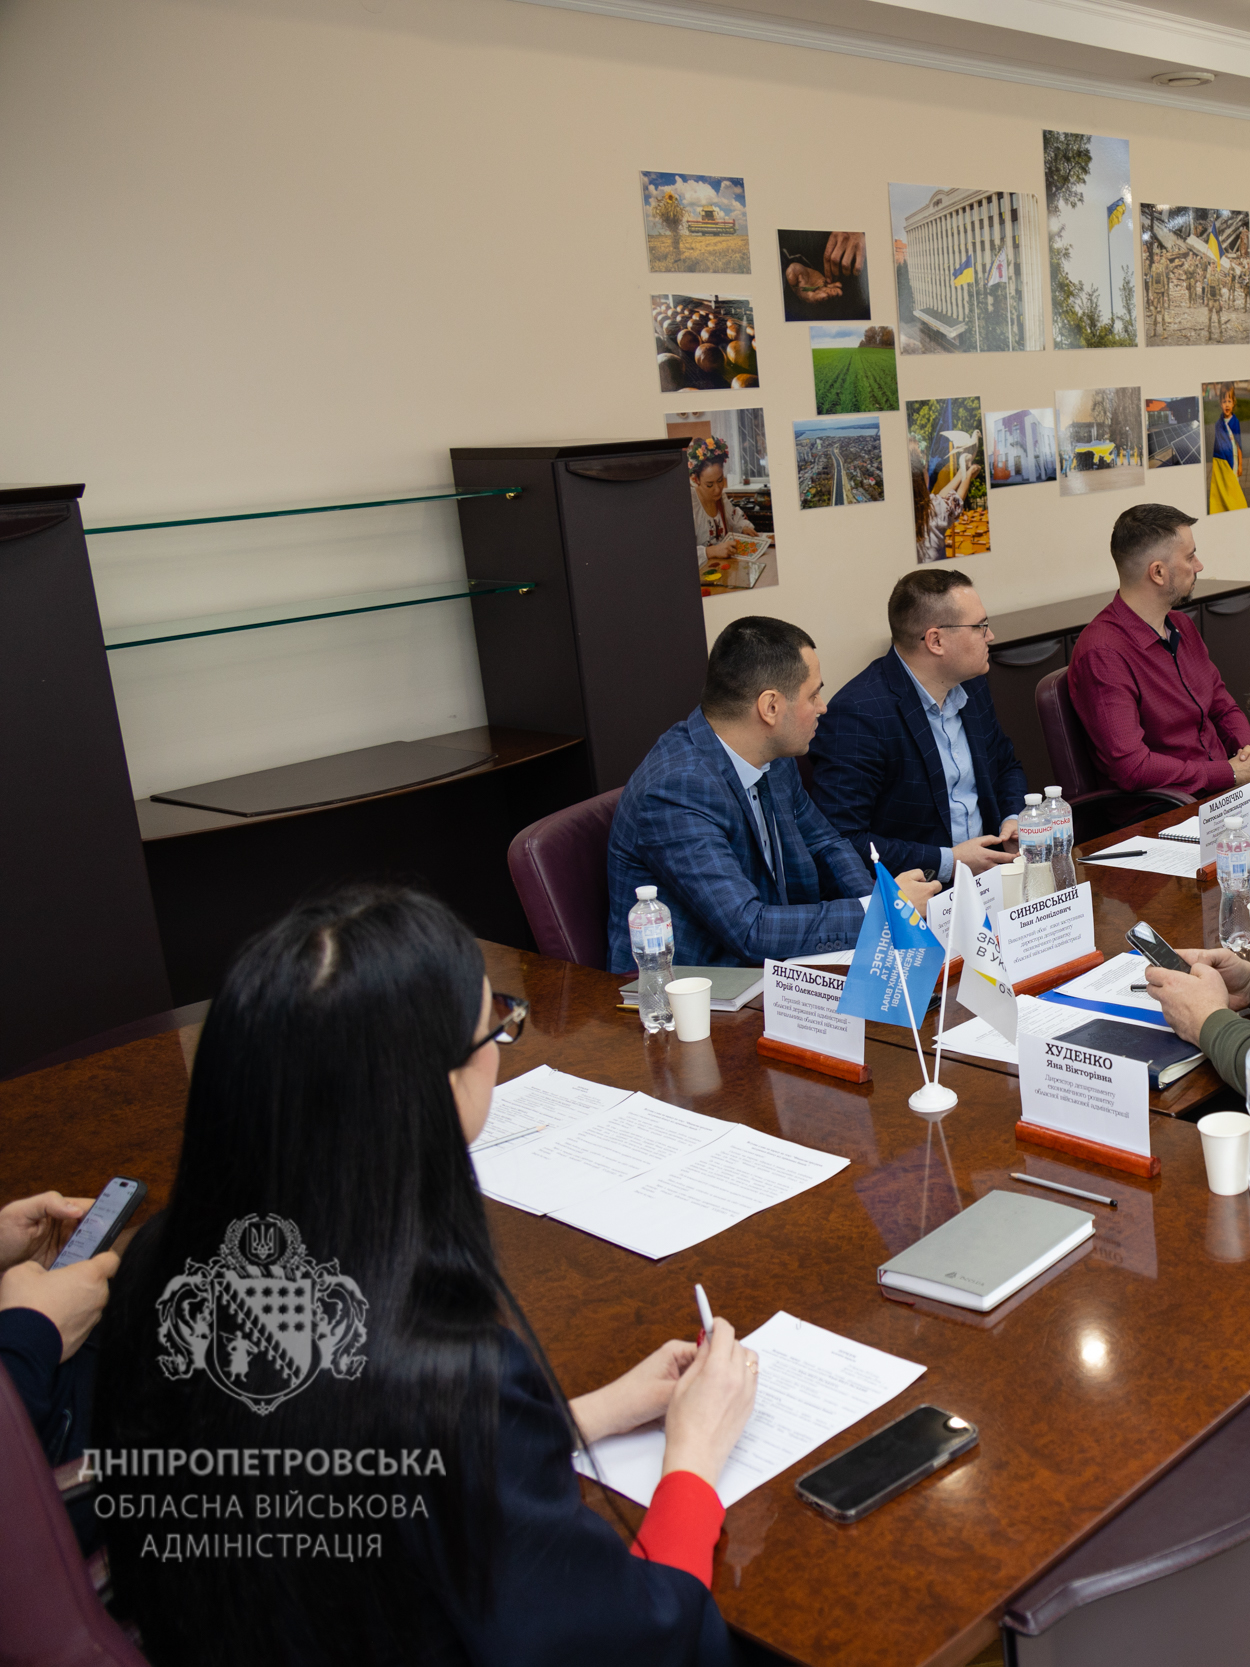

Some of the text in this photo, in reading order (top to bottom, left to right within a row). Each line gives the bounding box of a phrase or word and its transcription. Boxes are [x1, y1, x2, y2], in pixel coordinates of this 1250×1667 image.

[1209, 790, 1243, 813] МАЛОВІЧКО
[1020, 826, 1052, 835] моршинс
[1010, 886, 1078, 920] СИНЯВСЬКИЙ
[1020, 906, 1071, 928] Іван Леонідович
[772, 965, 845, 991] ЯНДУЛЬСЬКИ
[776, 980, 793, 991] Юрій
[1045, 1042, 1113, 1070] ХУДЕНКО
[1046, 1060, 1112, 1084] Яна Вікторівна
[1045, 1074, 1116, 1099] Директор департаменту
[1048, 1084, 1114, 1107] економічного розвитку
[1035, 1088, 1130, 1118] обласної військової адміністрації
